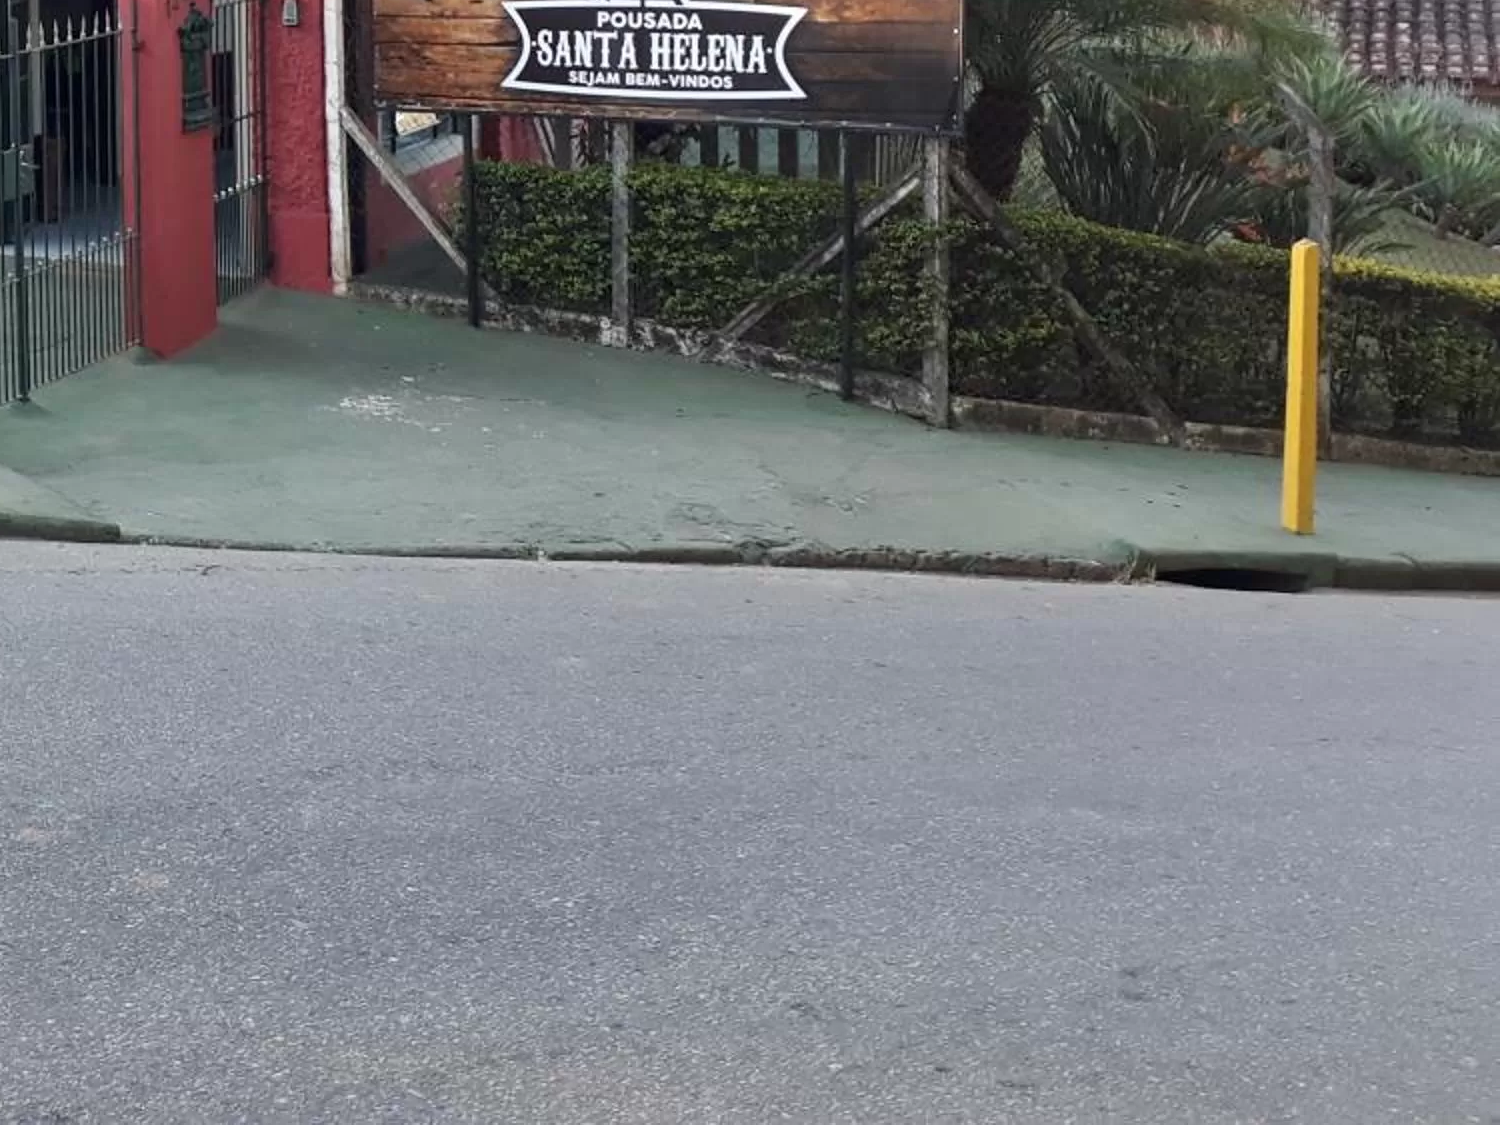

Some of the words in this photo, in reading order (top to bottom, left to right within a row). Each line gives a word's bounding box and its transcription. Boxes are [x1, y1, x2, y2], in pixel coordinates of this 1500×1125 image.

[597, 11, 703, 30] POUSADA
[536, 29, 639, 69] SANTA
[650, 33, 768, 74] HELENA
[568, 71, 620, 87] SEJAM
[626, 72, 733, 89] BEM-VINDOS
